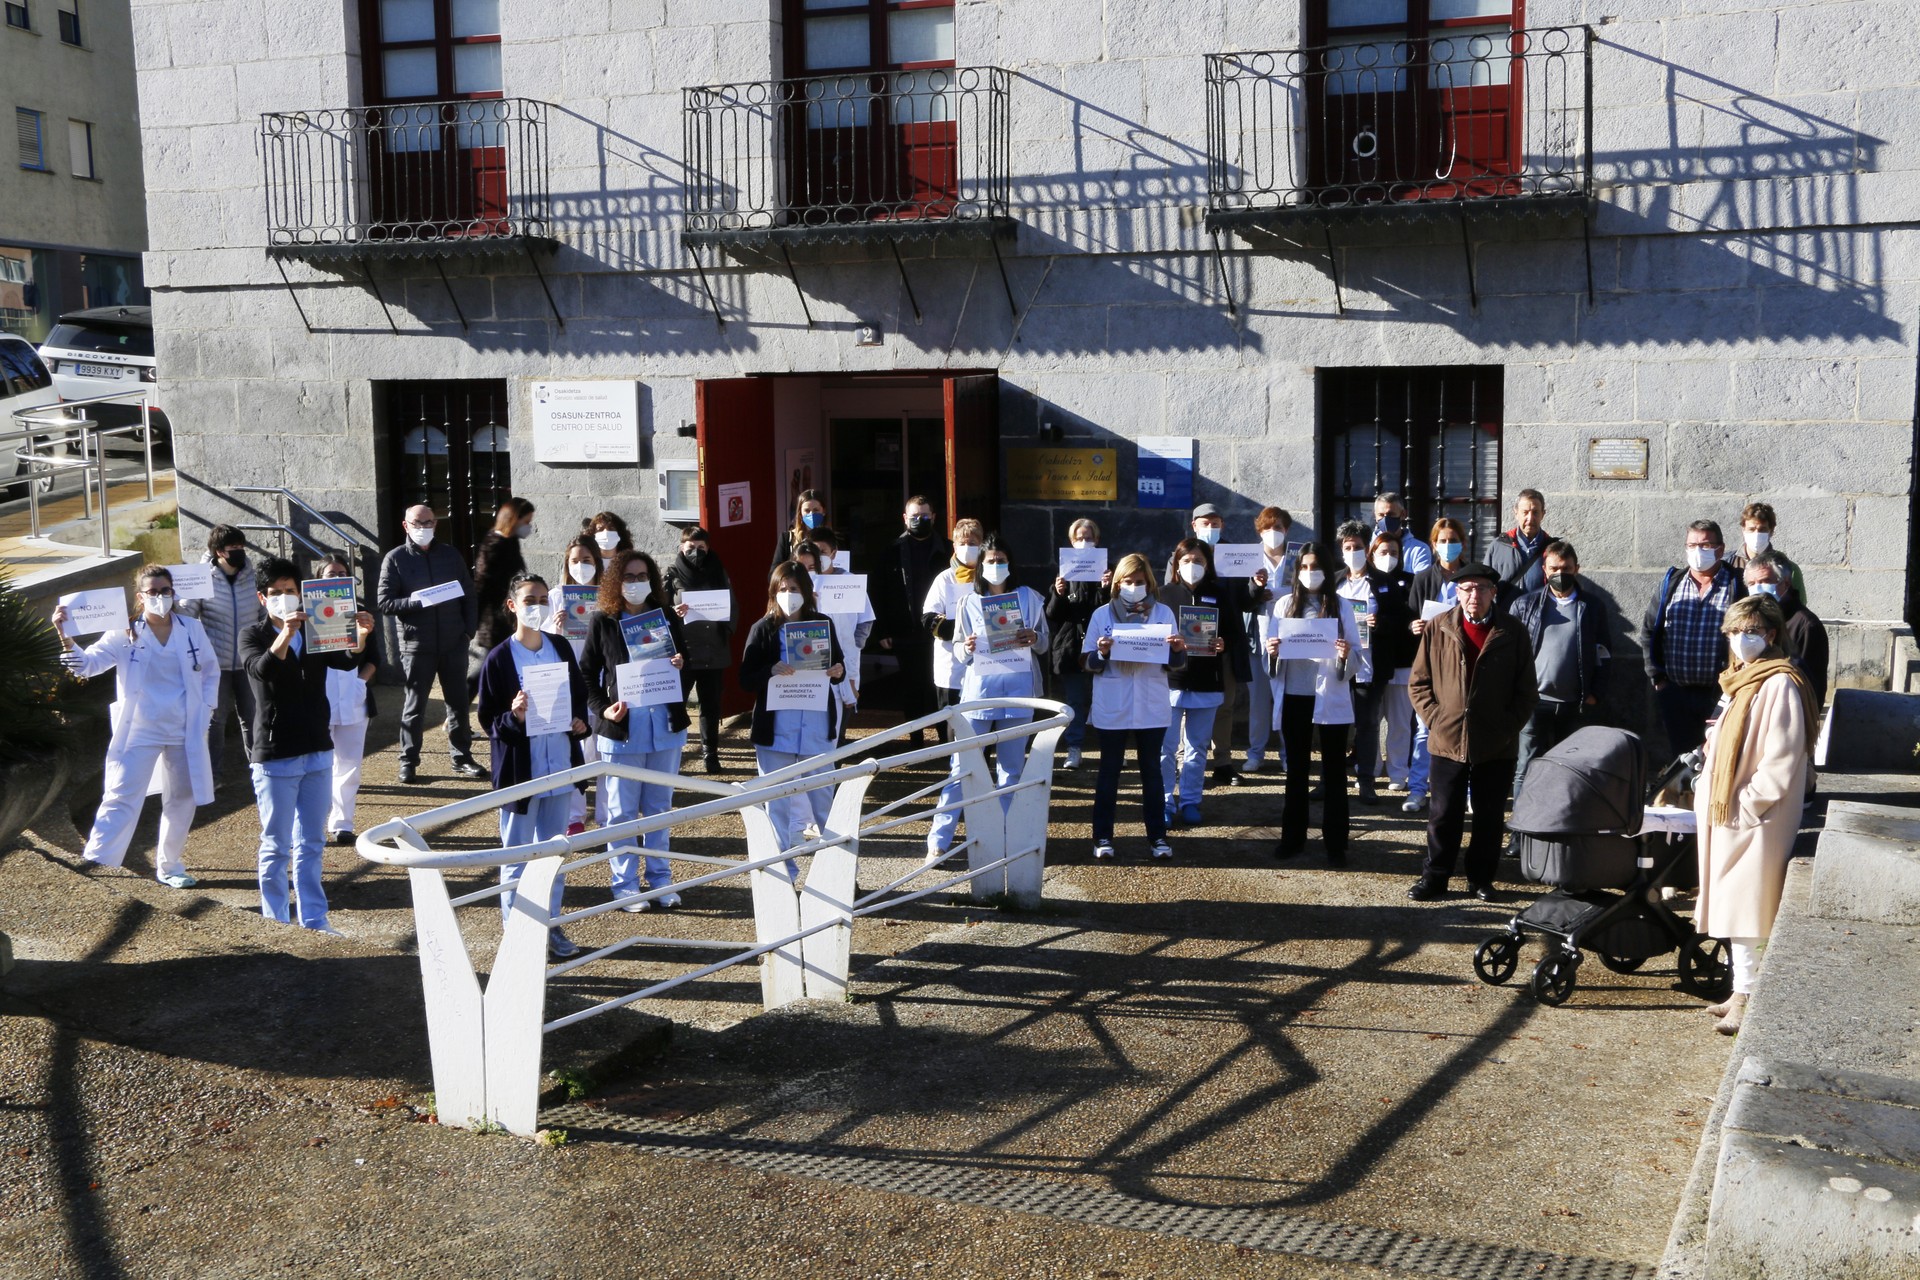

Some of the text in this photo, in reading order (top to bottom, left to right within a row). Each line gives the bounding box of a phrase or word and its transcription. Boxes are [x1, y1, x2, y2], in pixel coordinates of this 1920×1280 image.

[67, 352, 128, 361] DISCOVERY
[82, 365, 101, 374] 9939
[104, 368, 121, 376] KXY
[550, 411, 622, 420] OSASUN-ZENTROA
[550, 423, 623, 432] CENTRO DE SALUD
[307, 588, 350, 600] Nik BAI!
[565, 593, 581, 601] Nik
[985, 601, 1017, 612] Nik BAI!
[1183, 613, 1198, 621] Nik
[625, 624, 644, 636] Nik
[643, 618, 663, 630] BAI!
[789, 628, 827, 640] Nik BAI!
